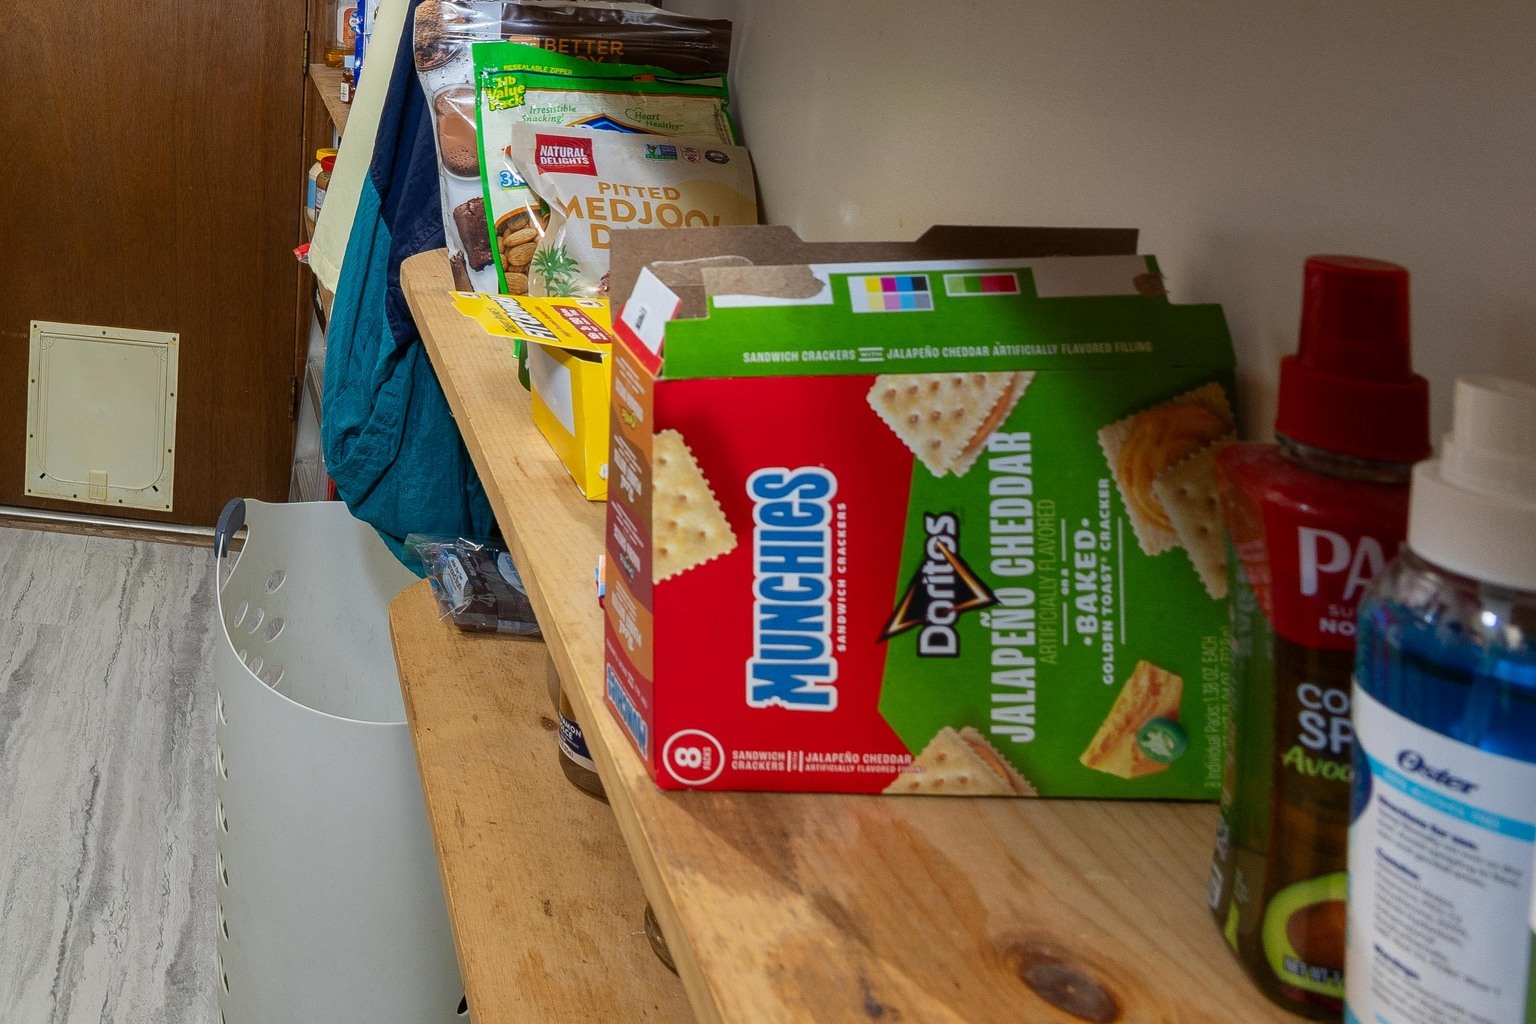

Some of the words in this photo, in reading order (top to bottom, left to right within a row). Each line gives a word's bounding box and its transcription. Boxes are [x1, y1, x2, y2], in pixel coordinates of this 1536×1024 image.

[545, 38, 624, 56] BETTER
[503, 64, 548, 74] RESEALABLE
[549, 66, 574, 76] ZIPPER
[487, 84, 526, 100] Value
[489, 95, 526, 112] Pack
[529, 104, 576, 114] Irresistible
[522, 113, 564, 124] Snacking!
[635, 111, 660, 120] Heart
[539, 145, 586, 158] NATURAL
[539, 155, 590, 166] DELIGHTS
[598, 181, 682, 202] PITTED
[742, 350, 800, 364] SANDWICH
[801, 349, 856, 362] CRACKERS
[886, 344, 940, 360] JALAPEÑO
[942, 344, 992, 358] CHEDDAR
[1061, 342, 1112, 356] FLAVORED
[989, 431, 1034, 578] CHEDDAR
[1098, 478, 1112, 552] CRACKER
[836, 502, 848, 574] CRACKERS
[1037, 499, 1058, 572] FLAVORED
[919, 515, 958, 656] Doritos
[836, 577, 848, 654] SANDWICH
[1038, 576, 1058, 664] ARTIFICIALLY
[1102, 620, 1114, 686] GOLDEN
[979, 586, 1036, 744] JALAPEÑO
[674, 746, 702, 770] 8
[703, 746, 712, 772] PACKS
[732, 750, 786, 762] SANDWICH
[732, 760, 786, 772] CRACKERS
[805, 750, 860, 764] JALAPEÑO
[863, 753, 912, 764] CHEDDAR
[805, 764, 856, 774] ARTIFICIALLY
[857, 765, 896, 774] FLAVORED
[1397, 749, 1480, 794] Oster
